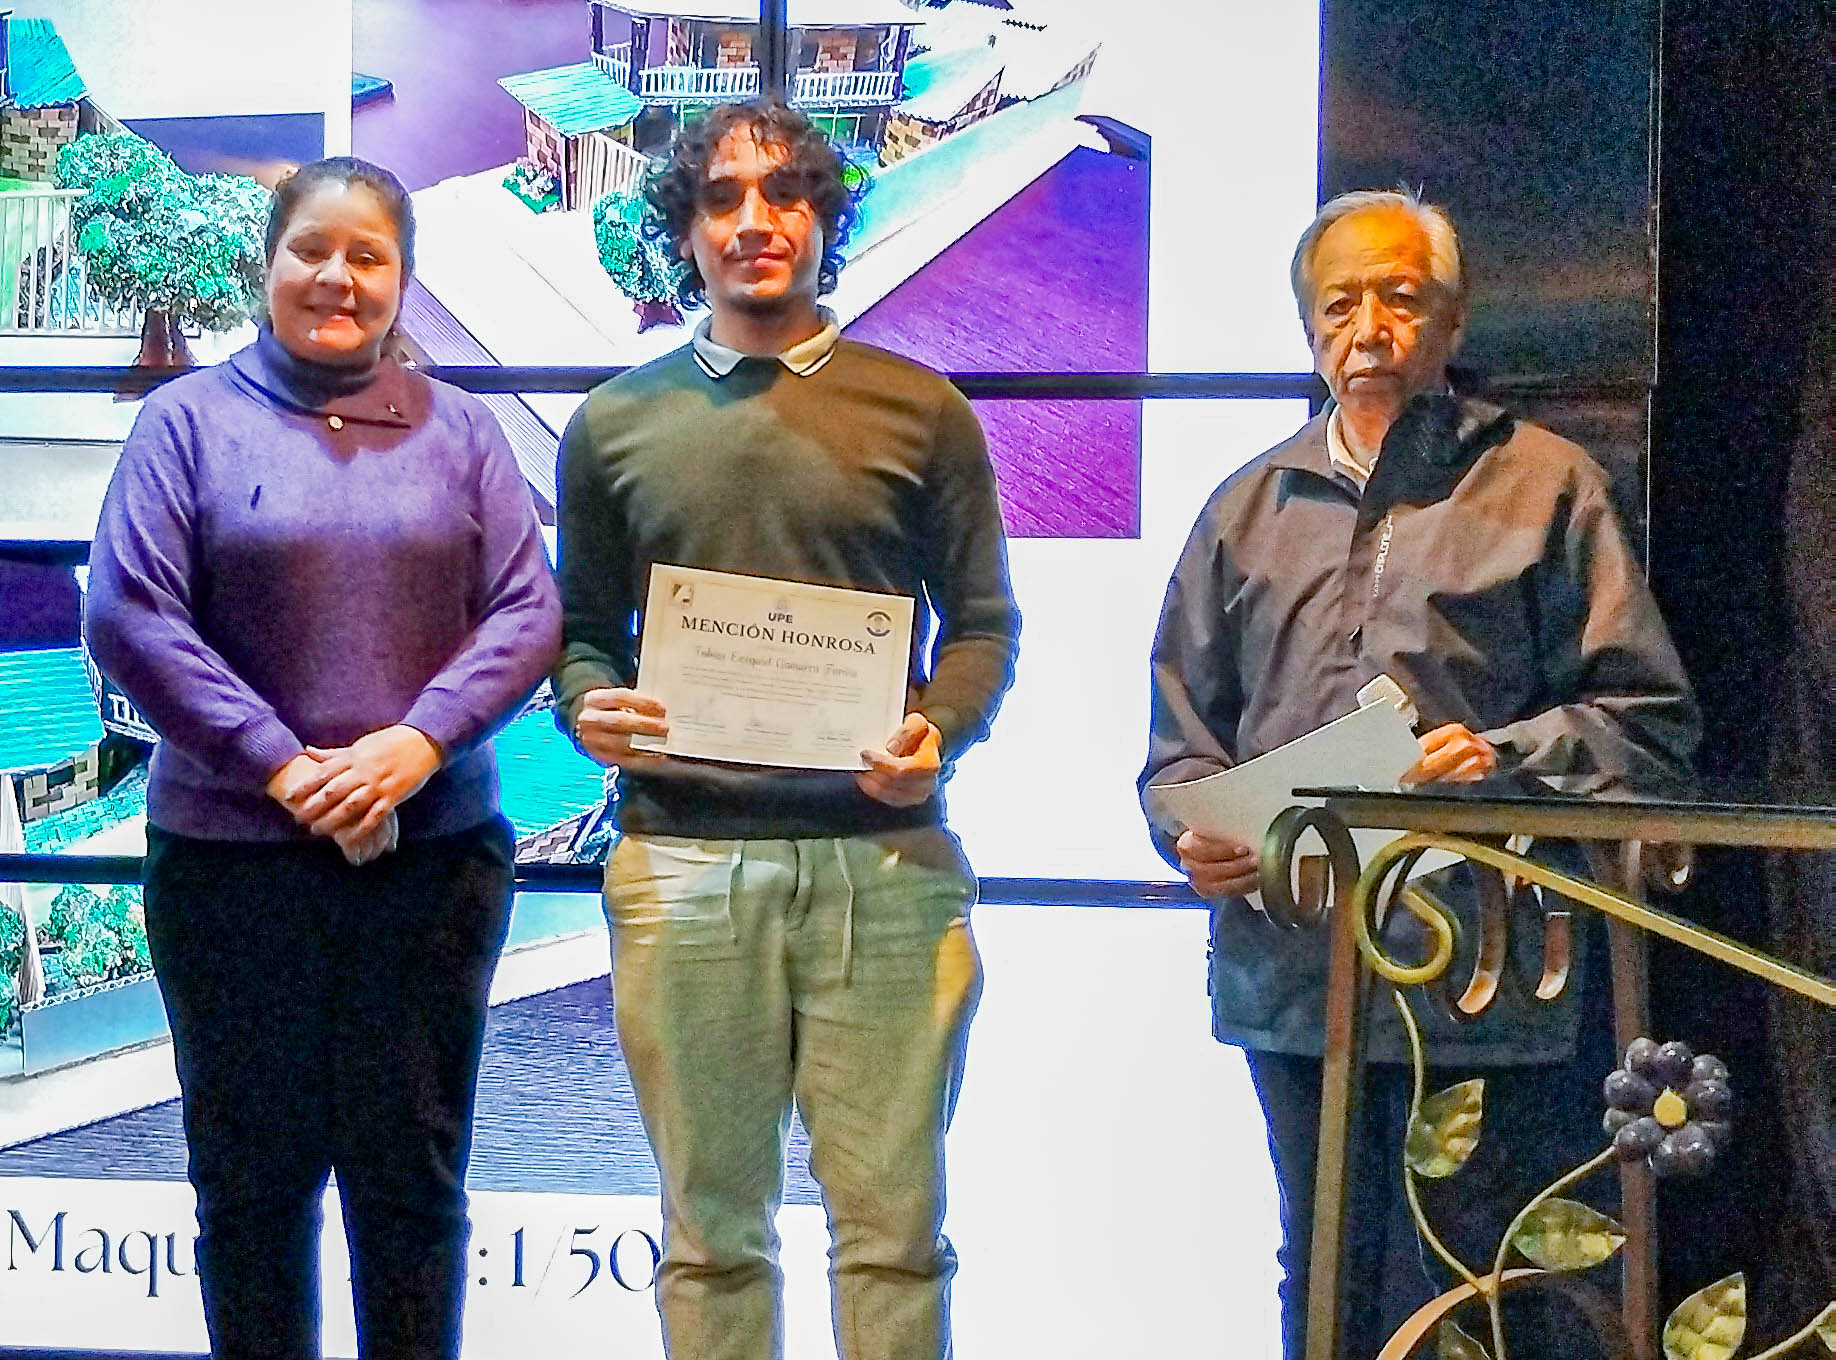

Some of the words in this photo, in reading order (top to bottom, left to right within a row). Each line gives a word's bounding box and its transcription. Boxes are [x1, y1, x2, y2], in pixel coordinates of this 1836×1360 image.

[681, 615, 775, 641] MENCIÓN
[781, 630, 876, 655] HONROSA
[768, 612, 794, 624] UPE
[7, 1209, 202, 1298] Maqu
